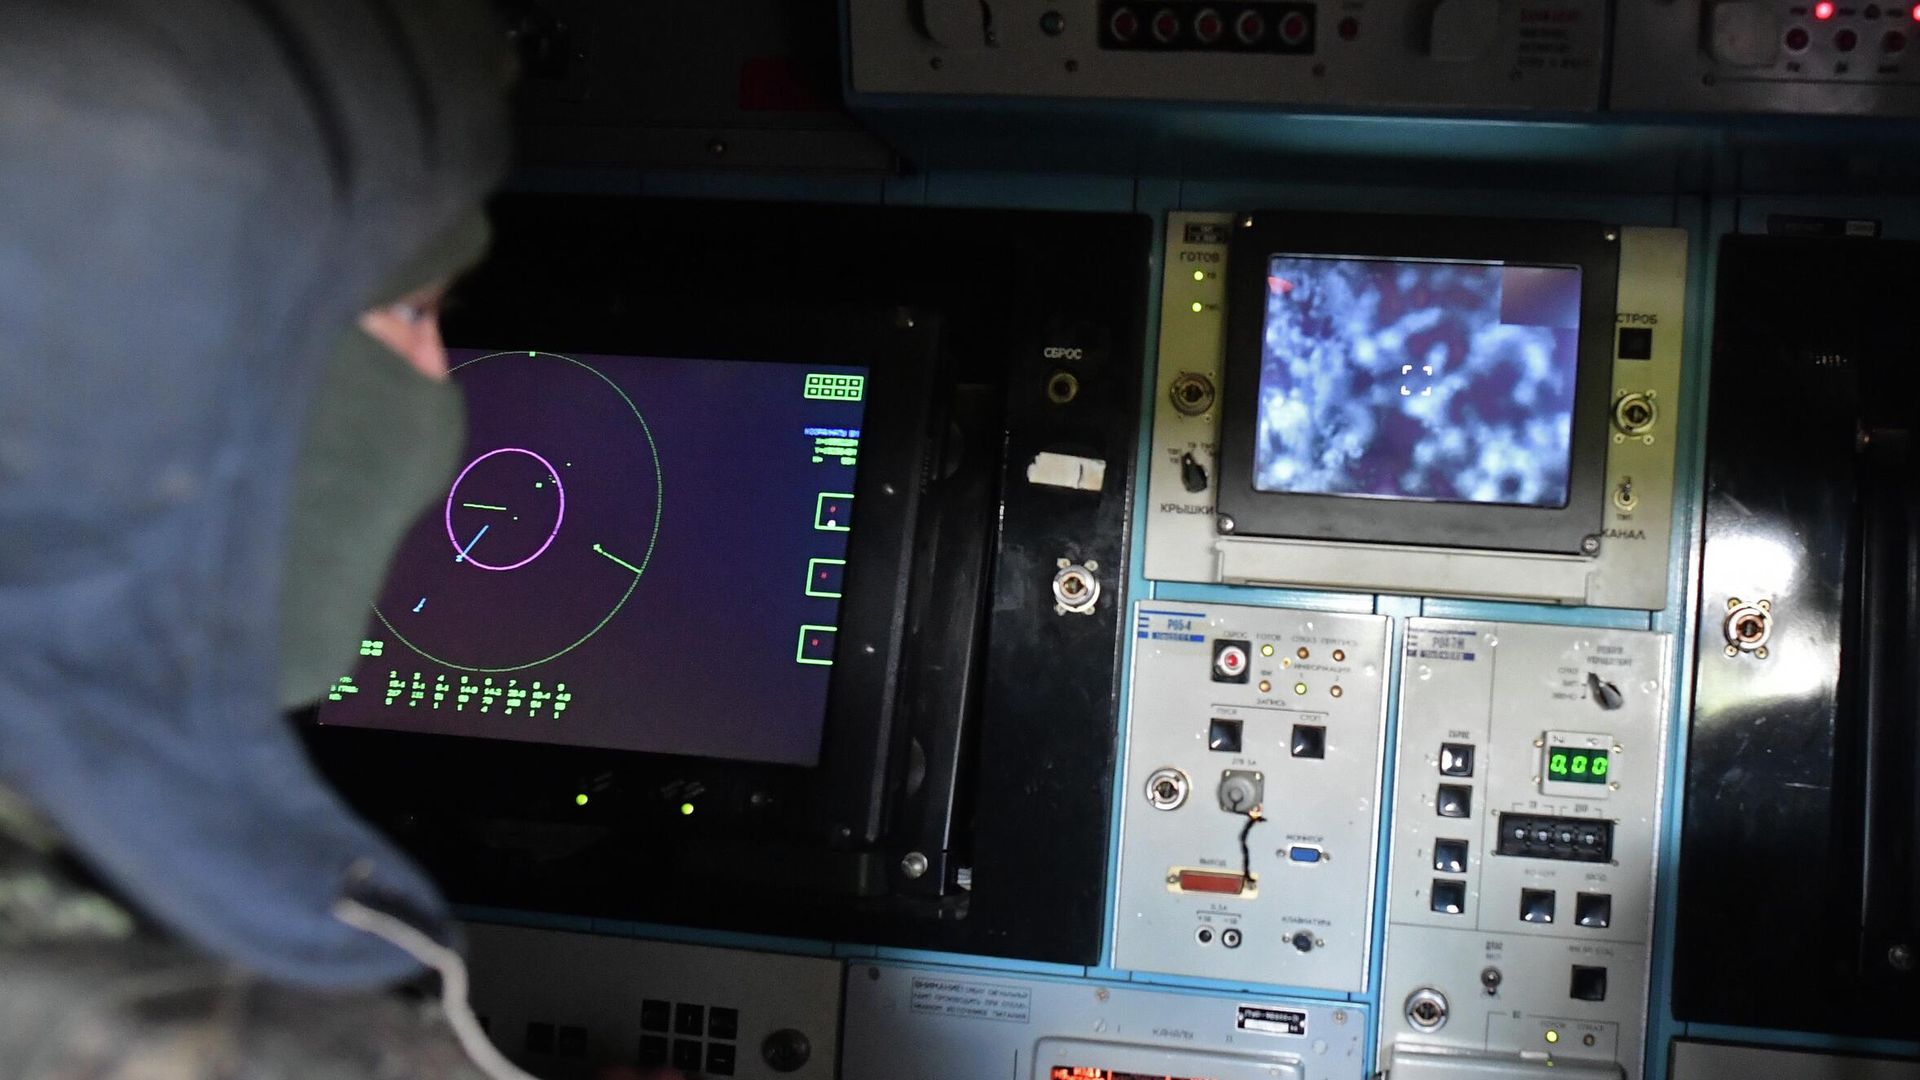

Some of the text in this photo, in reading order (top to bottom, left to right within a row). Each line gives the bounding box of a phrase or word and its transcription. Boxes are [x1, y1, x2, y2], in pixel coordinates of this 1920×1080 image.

[1616, 313, 1657, 325] СТРОБ
[1043, 347, 1083, 360] СБРОС
[1160, 504, 1215, 515] КРЫШКИ
